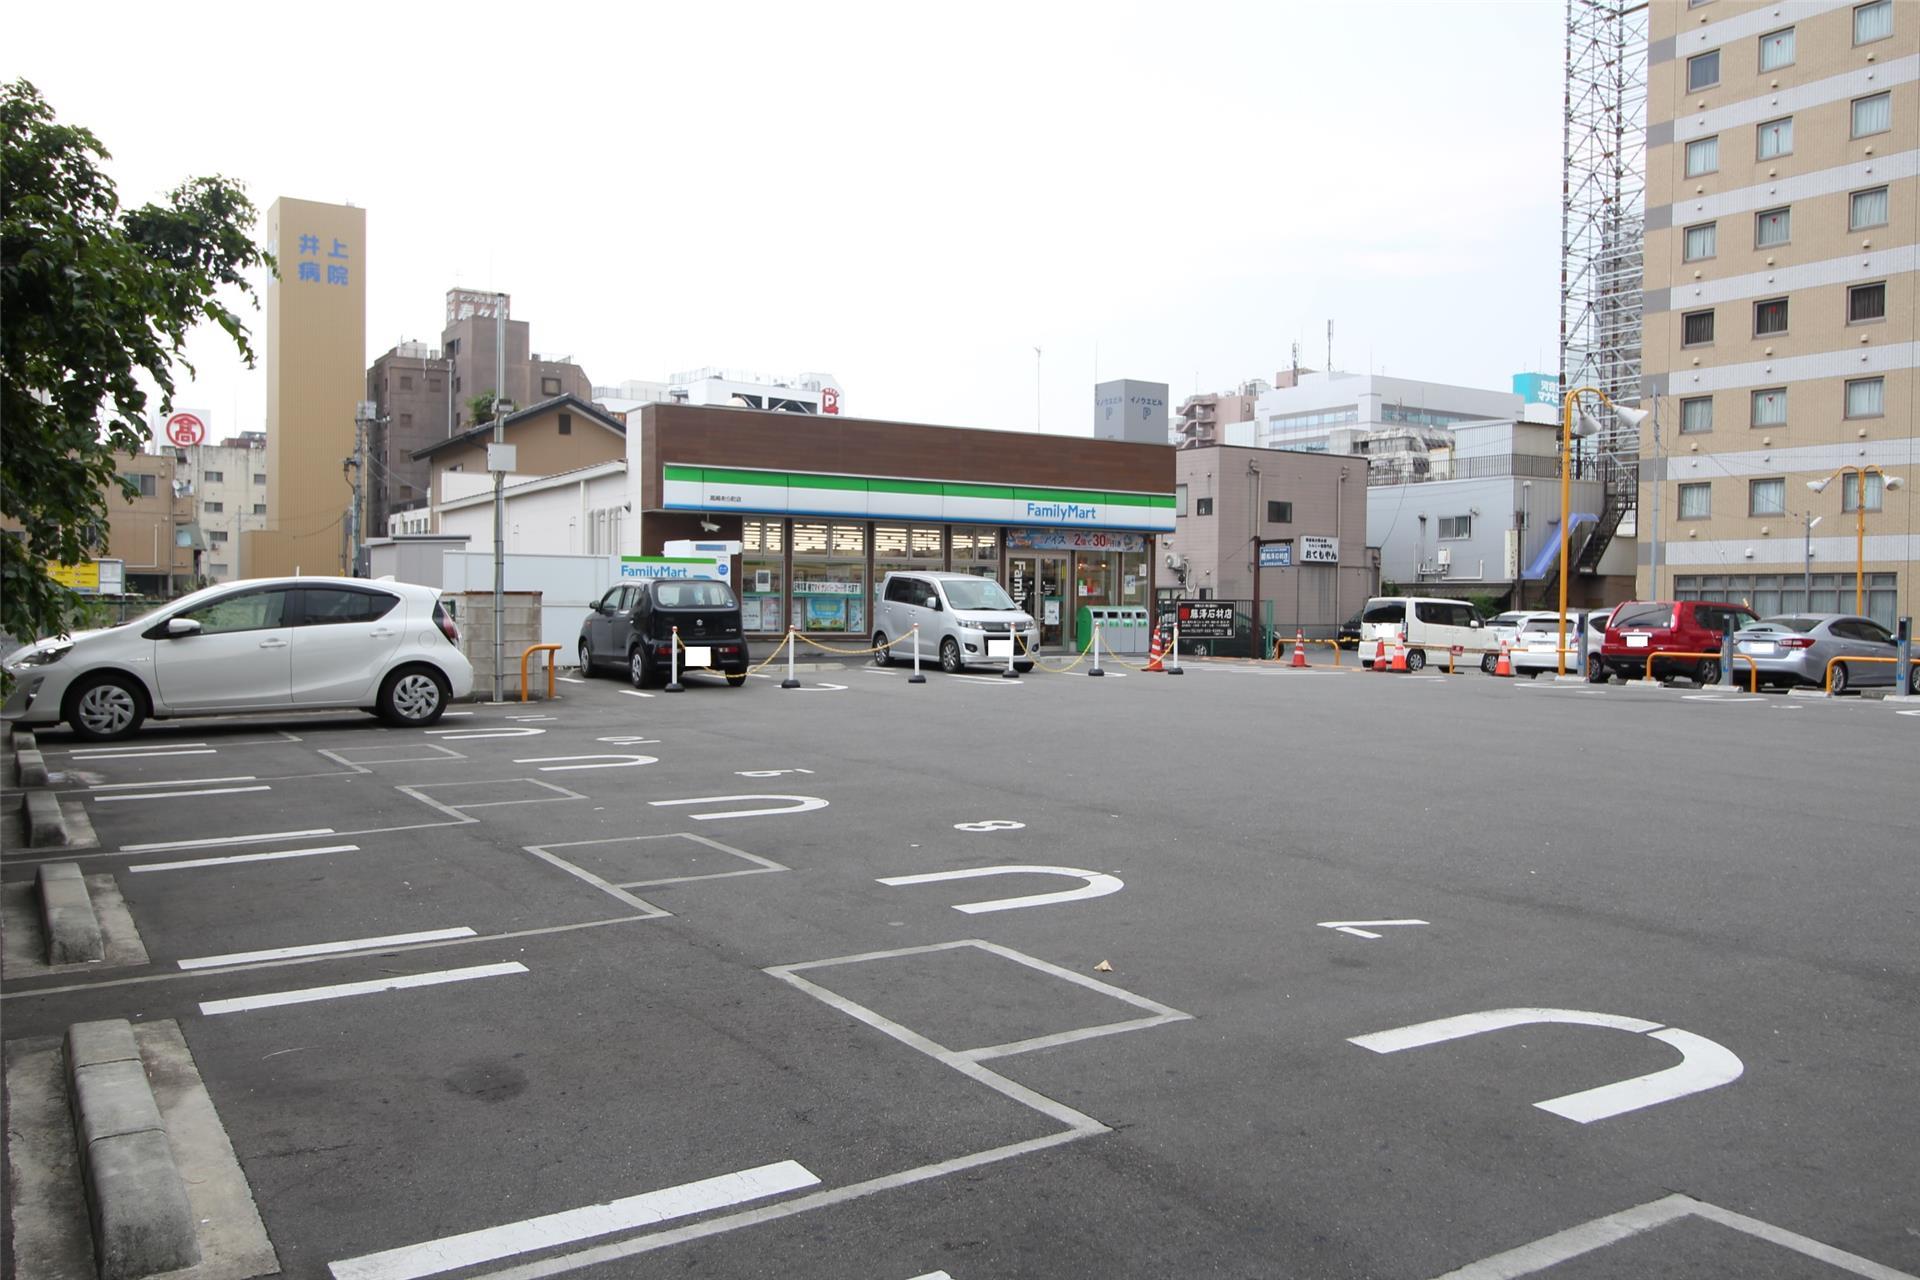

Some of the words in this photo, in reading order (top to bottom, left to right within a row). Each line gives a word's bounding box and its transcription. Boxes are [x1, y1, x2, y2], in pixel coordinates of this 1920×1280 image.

[298, 233, 349, 259] 井上
[298, 261, 349, 287] 病院
[1131, 396, 1163, 406] イノウエビル
[1143, 407, 1152, 421] P
[1027, 502, 1096, 521] FamilyMart
[1045, 535, 1066, 545] アイス
[1305, 550, 1337, 560] おてもやん
[621, 565, 688, 578] FamilyMart
[953, 820, 1026, 832] 8
